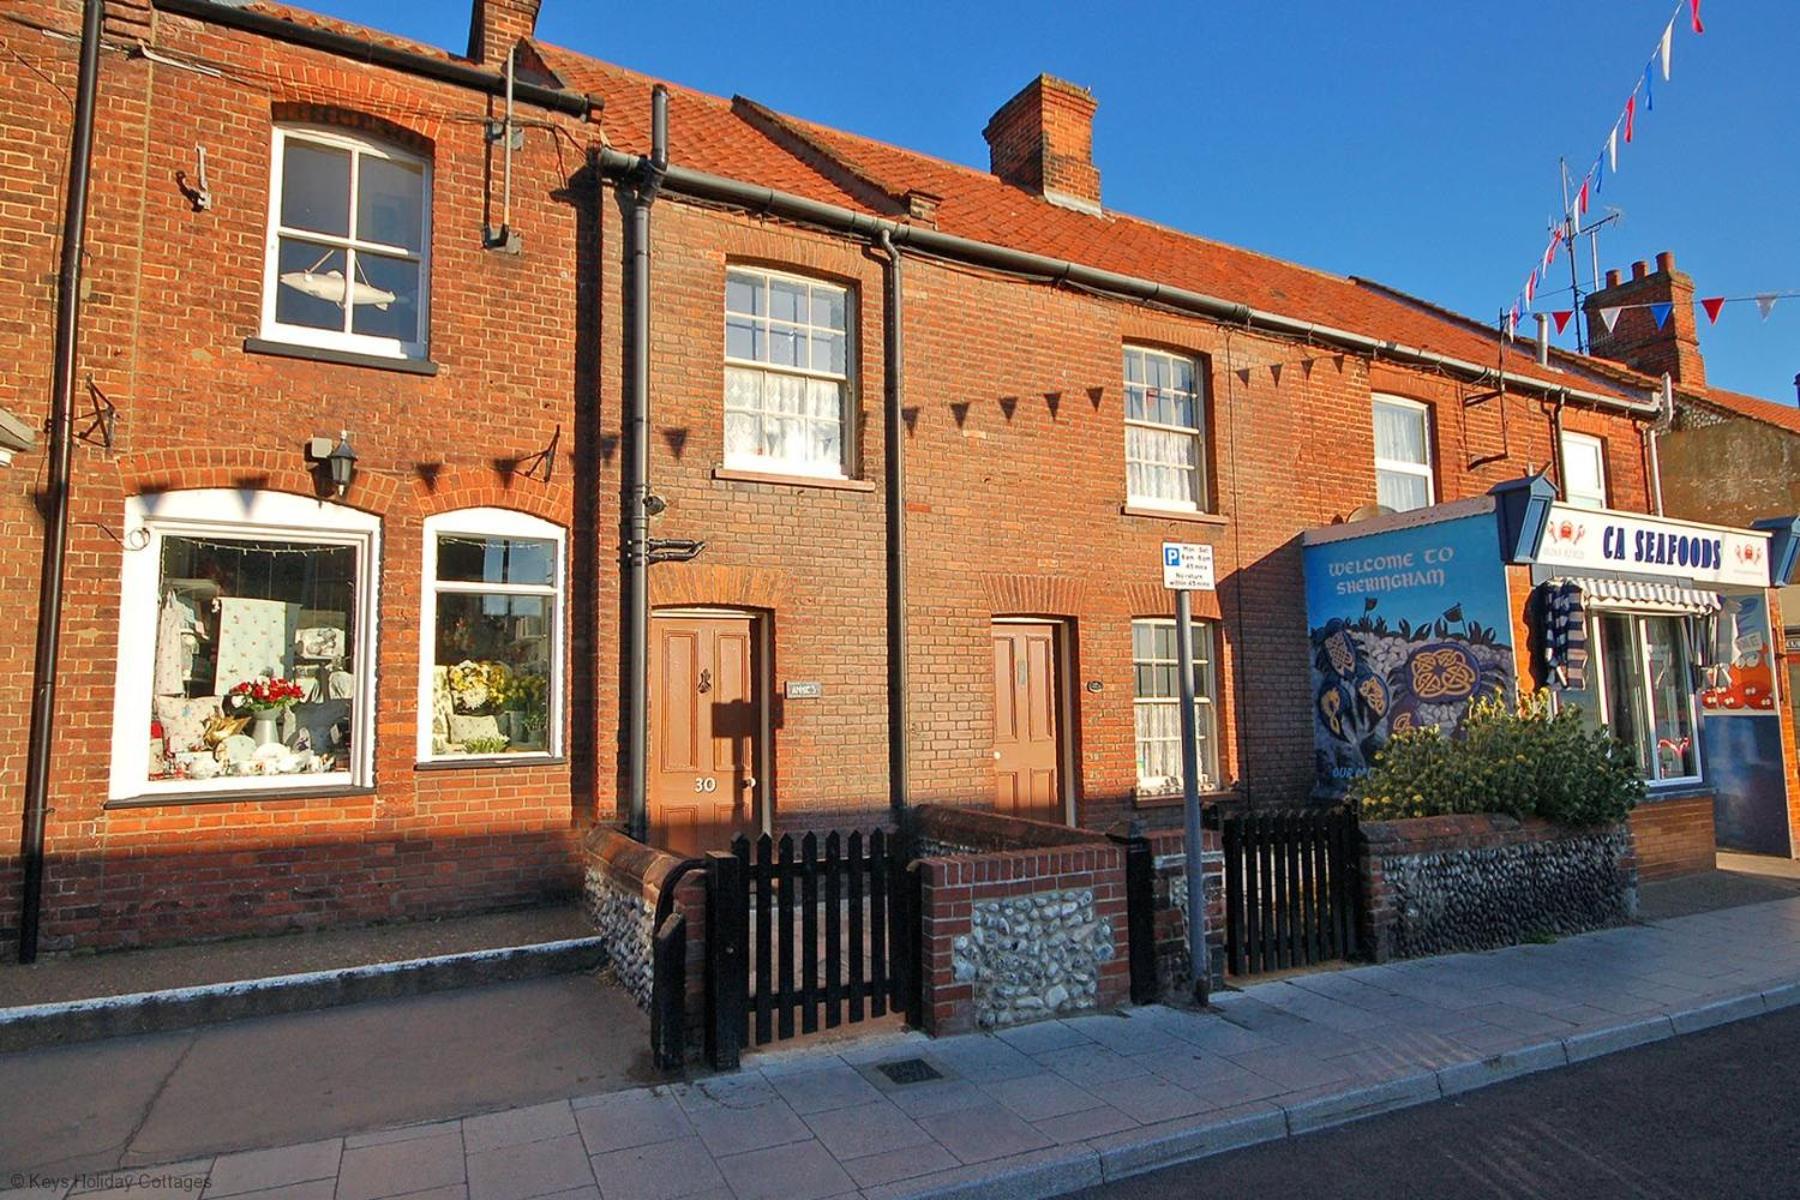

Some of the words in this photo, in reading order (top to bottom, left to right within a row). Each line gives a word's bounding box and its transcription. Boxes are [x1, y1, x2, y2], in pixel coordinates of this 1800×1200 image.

[1168, 550, 1178, 565] P
[1328, 552, 1414, 577] WELCOME
[1424, 547, 1456, 564] TO
[1603, 526, 1626, 560] CA
[1635, 530, 1721, 570] SEAFOODS
[1336, 568, 1446, 596] SHERINGHAM
[695, 777, 716, 792] 30
